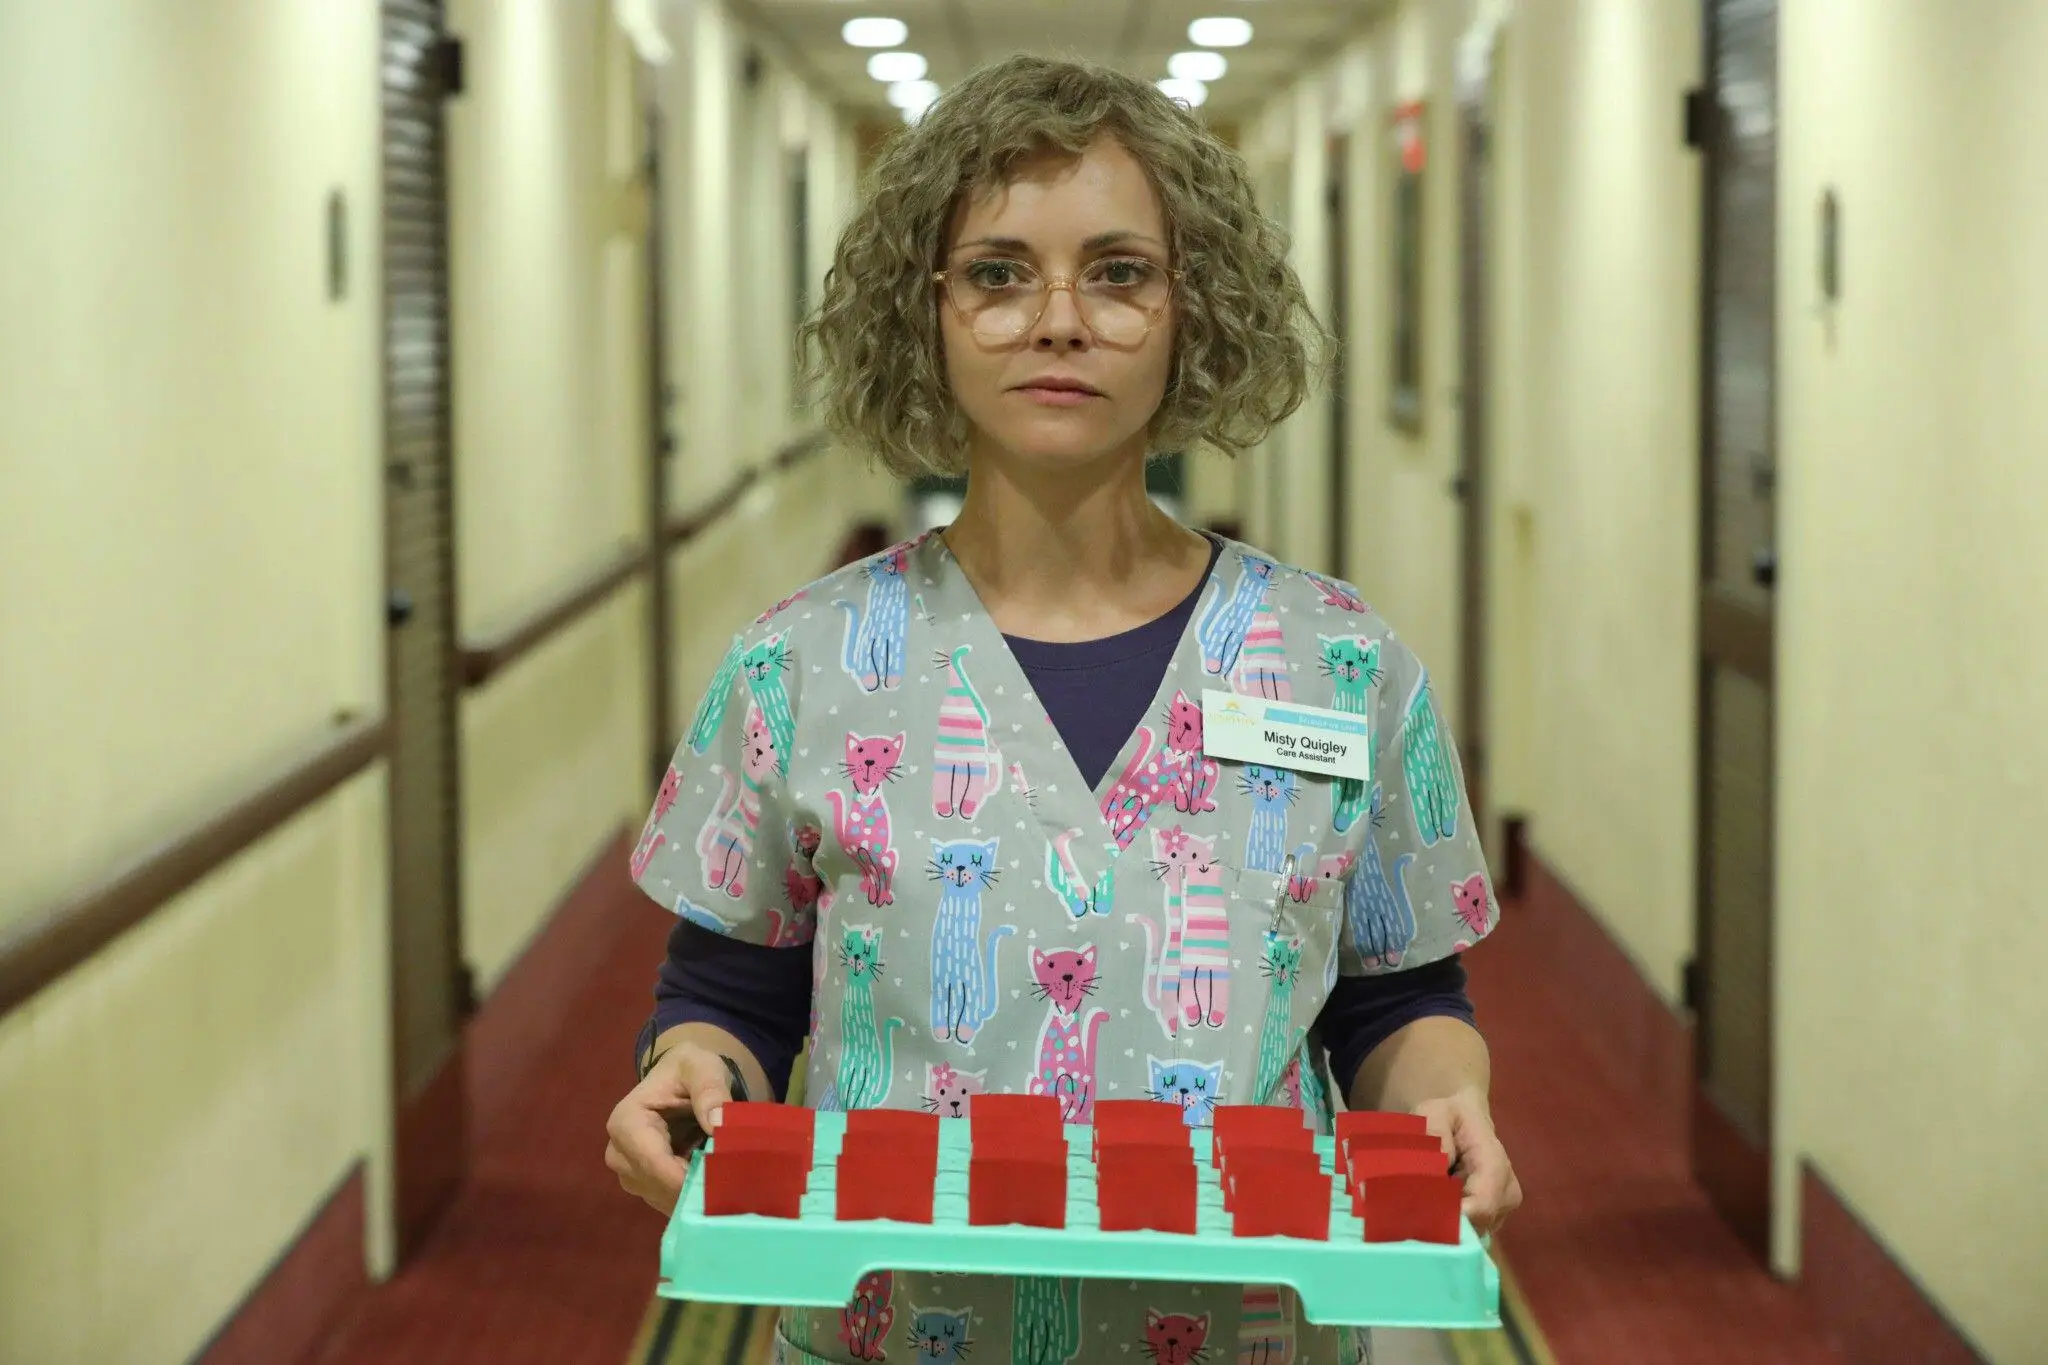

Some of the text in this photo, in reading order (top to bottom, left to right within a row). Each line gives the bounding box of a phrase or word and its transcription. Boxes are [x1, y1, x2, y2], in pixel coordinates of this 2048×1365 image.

[1264, 730, 1347, 757] Misty Quigley
[1276, 747, 1336, 764] Care Assistant
